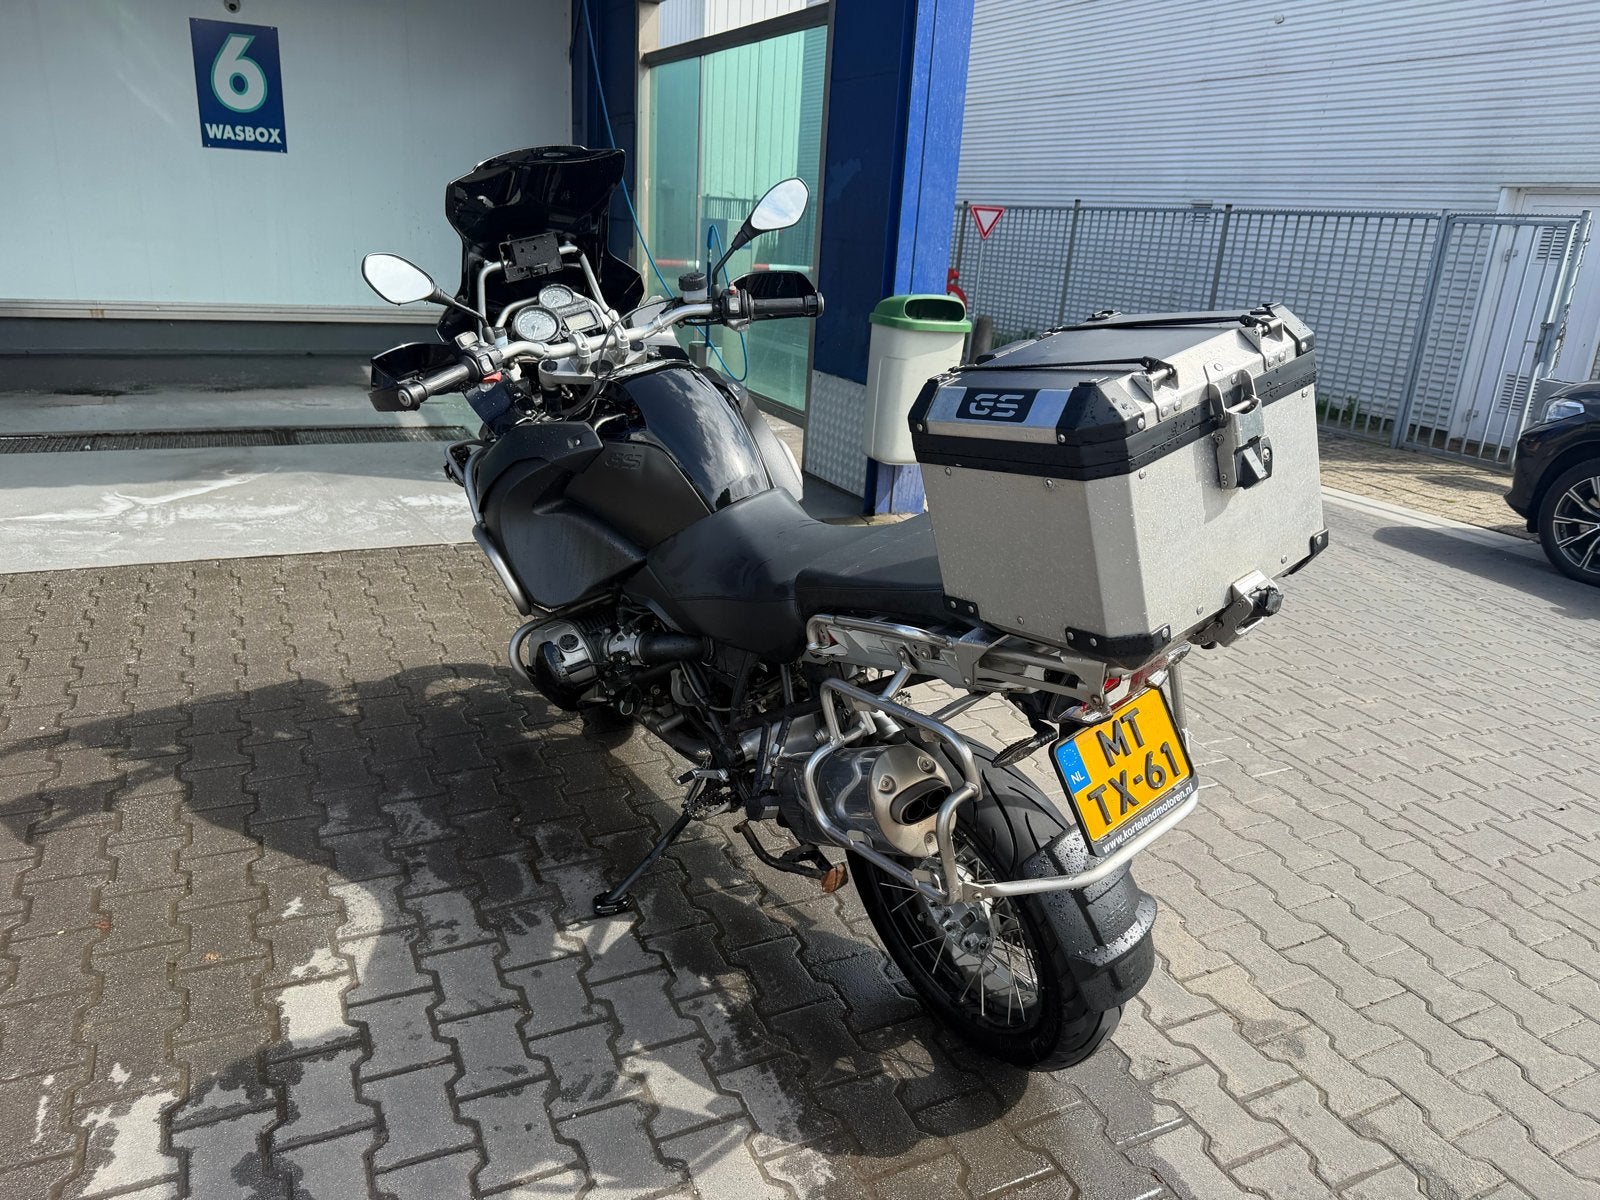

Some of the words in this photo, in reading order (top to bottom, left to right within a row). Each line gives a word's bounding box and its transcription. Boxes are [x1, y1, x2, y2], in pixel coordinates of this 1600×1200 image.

[211, 33, 267, 113] 6
[205, 123, 281, 144] WASBOX
[969, 393, 1025, 418] GS
[605, 453, 643, 469] GS
[1095, 707, 1145, 767] MT
[1070, 770, 1086, 785] NL
[1087, 741, 1181, 826] TX-61
[1102, 783, 1194, 854] www.kortelandmotoren.nl
